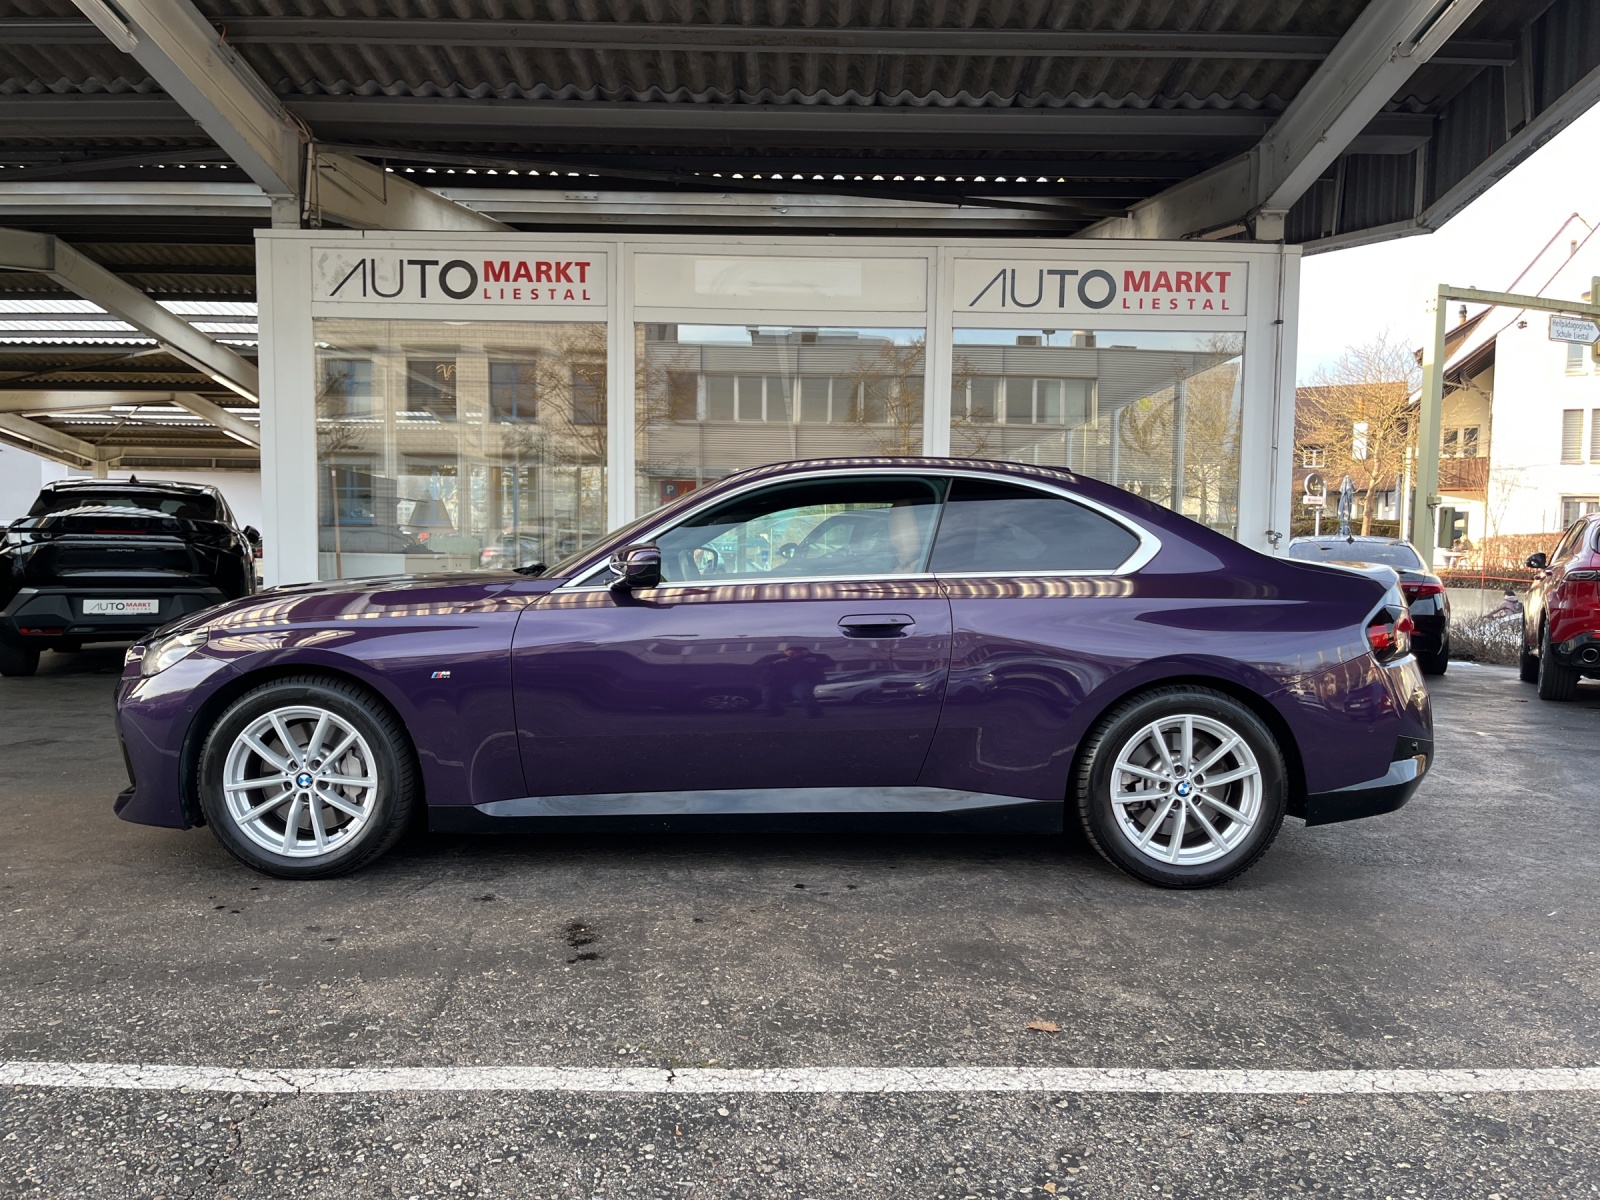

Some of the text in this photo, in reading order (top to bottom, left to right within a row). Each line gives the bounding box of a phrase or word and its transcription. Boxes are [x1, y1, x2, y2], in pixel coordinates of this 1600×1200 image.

[329, 258, 591, 300] AUTO MARKT
[484, 288, 591, 301] LIESTAL
[968, 268, 1232, 310] AUTO MARKT
[1123, 297, 1230, 311] LIESTAL
[1552, 319, 1594, 331] Heilpädagogische
[1556, 330, 1589, 340] Schule Liestal
[91, 602, 125, 611] AUTO
